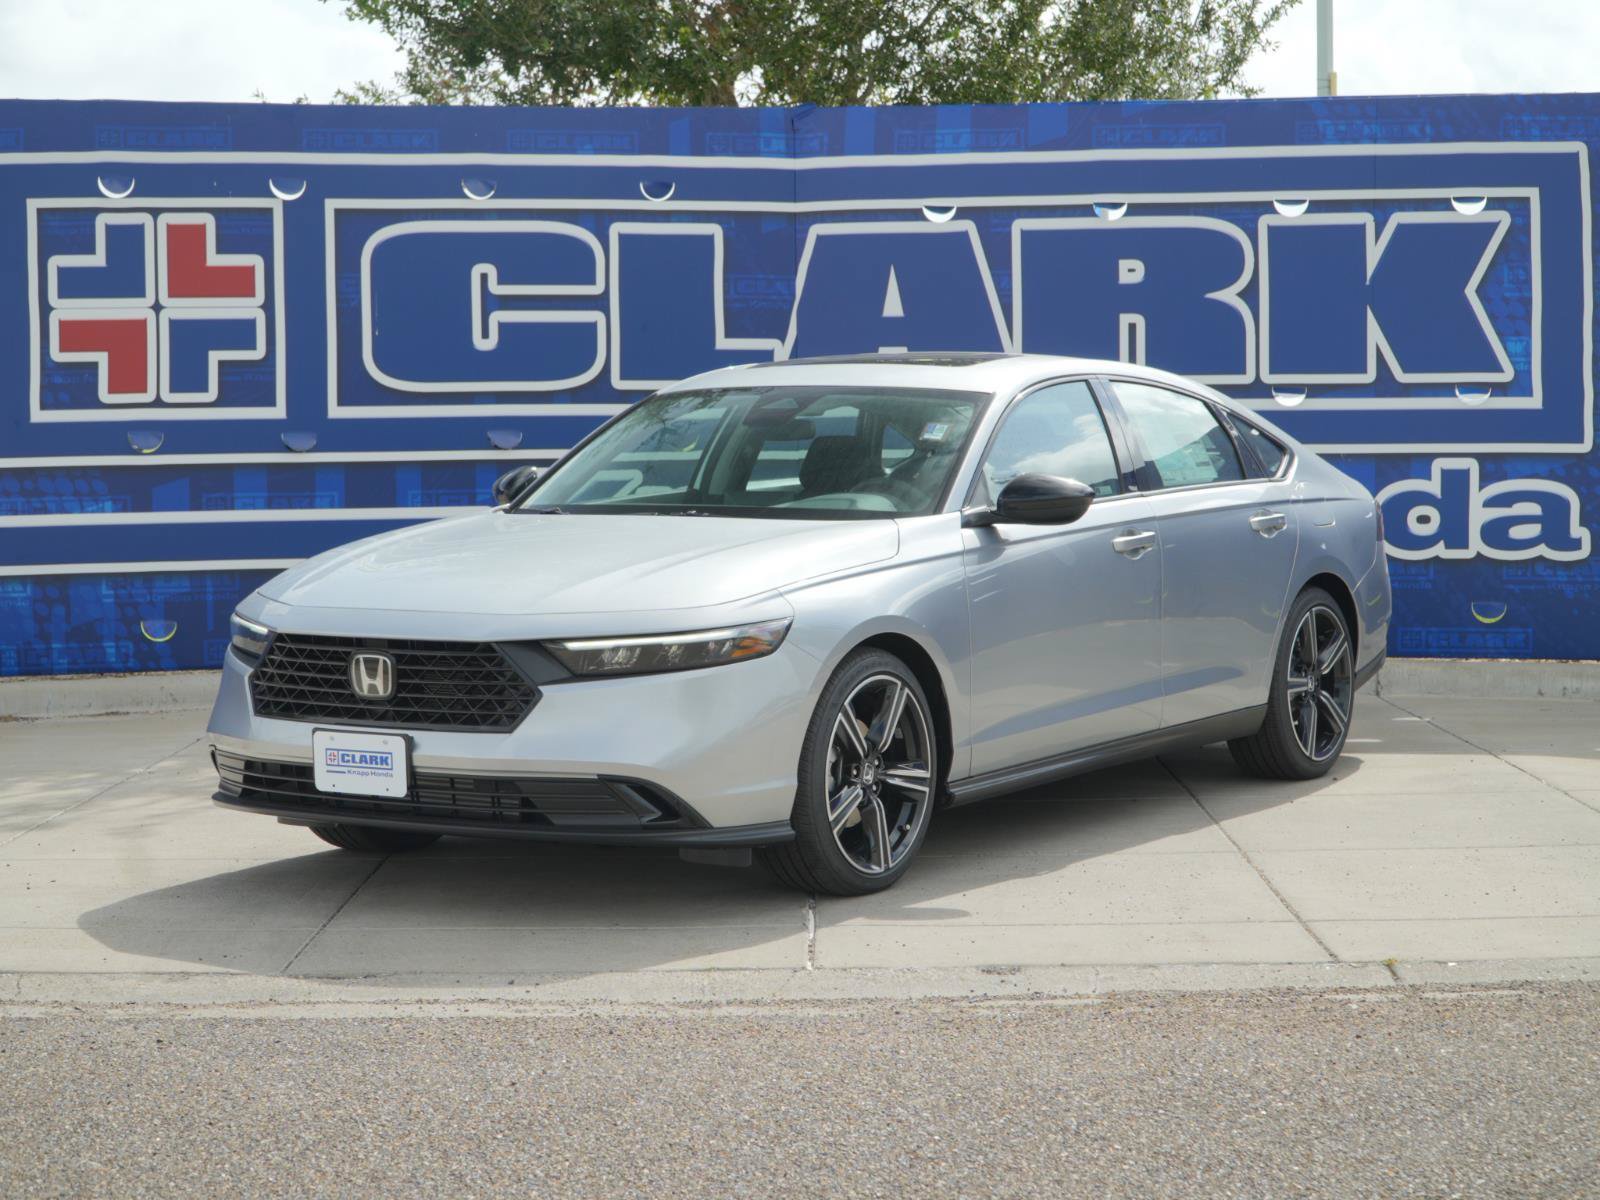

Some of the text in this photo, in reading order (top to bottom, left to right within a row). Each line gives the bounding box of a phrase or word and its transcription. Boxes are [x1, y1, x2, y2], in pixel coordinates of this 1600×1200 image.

[360, 211, 1515, 393] CLARK
[340, 752, 390, 767] CLARK
[370, 770, 393, 778] Honda
